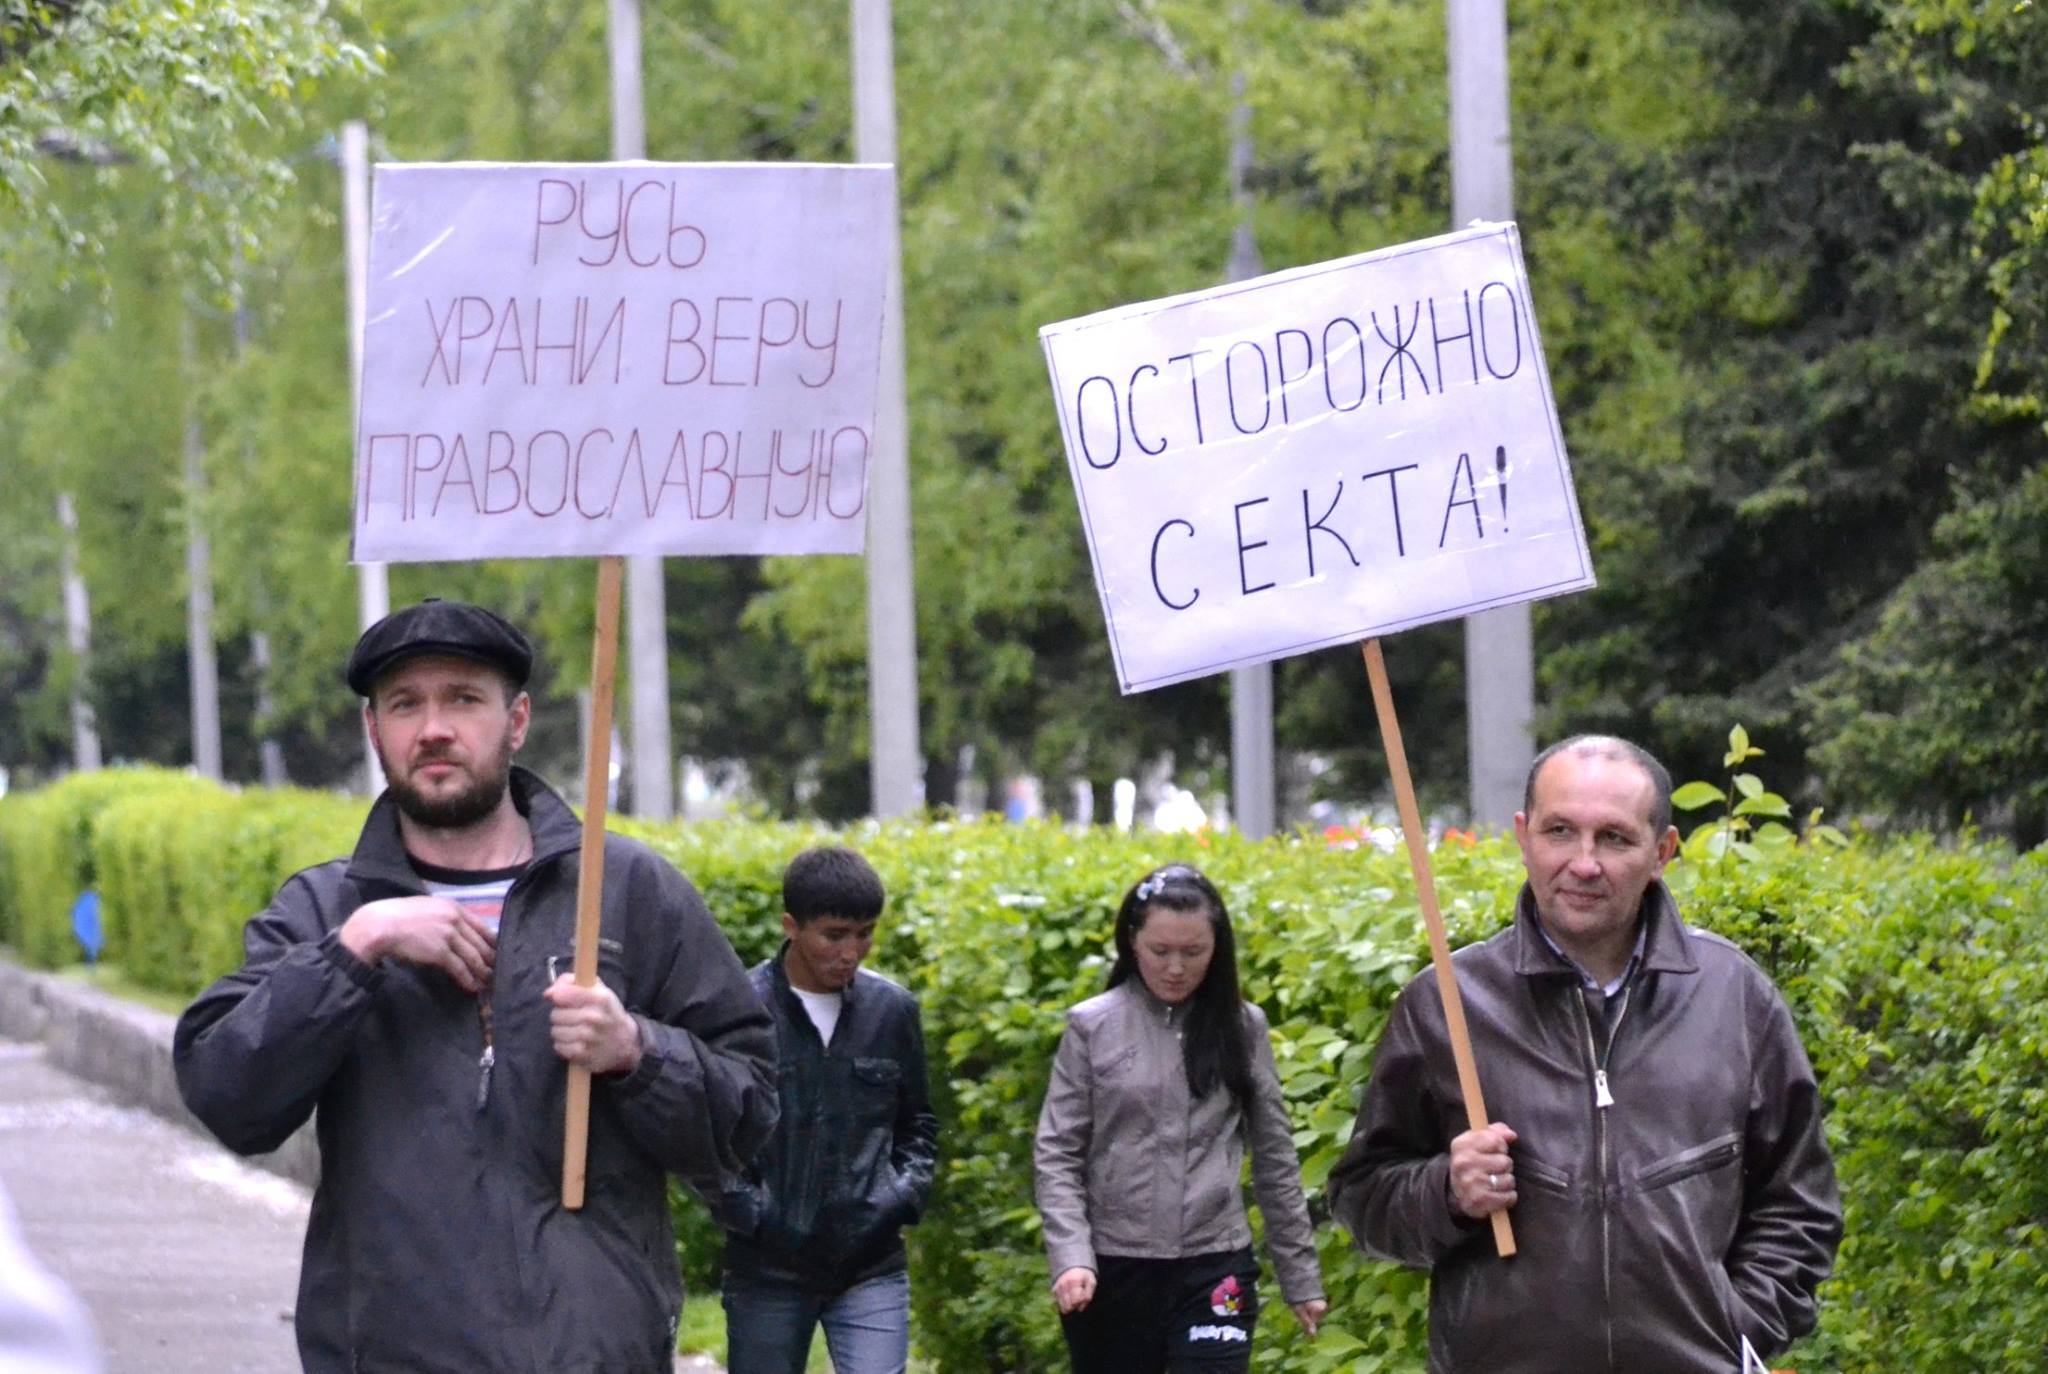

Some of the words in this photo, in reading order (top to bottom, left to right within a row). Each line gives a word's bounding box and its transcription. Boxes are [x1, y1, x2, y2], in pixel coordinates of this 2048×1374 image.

[534, 179, 706, 269] РУСЬ
[421, 297, 626, 388] ХРАНИ
[663, 297, 842, 388] ВЕРУ
[1077, 281, 1521, 470] ОСТОРОЖНО
[364, 426, 869, 523] ПРАВОСЛАВНУЮ
[1149, 445, 1510, 611] СЕКТА!
